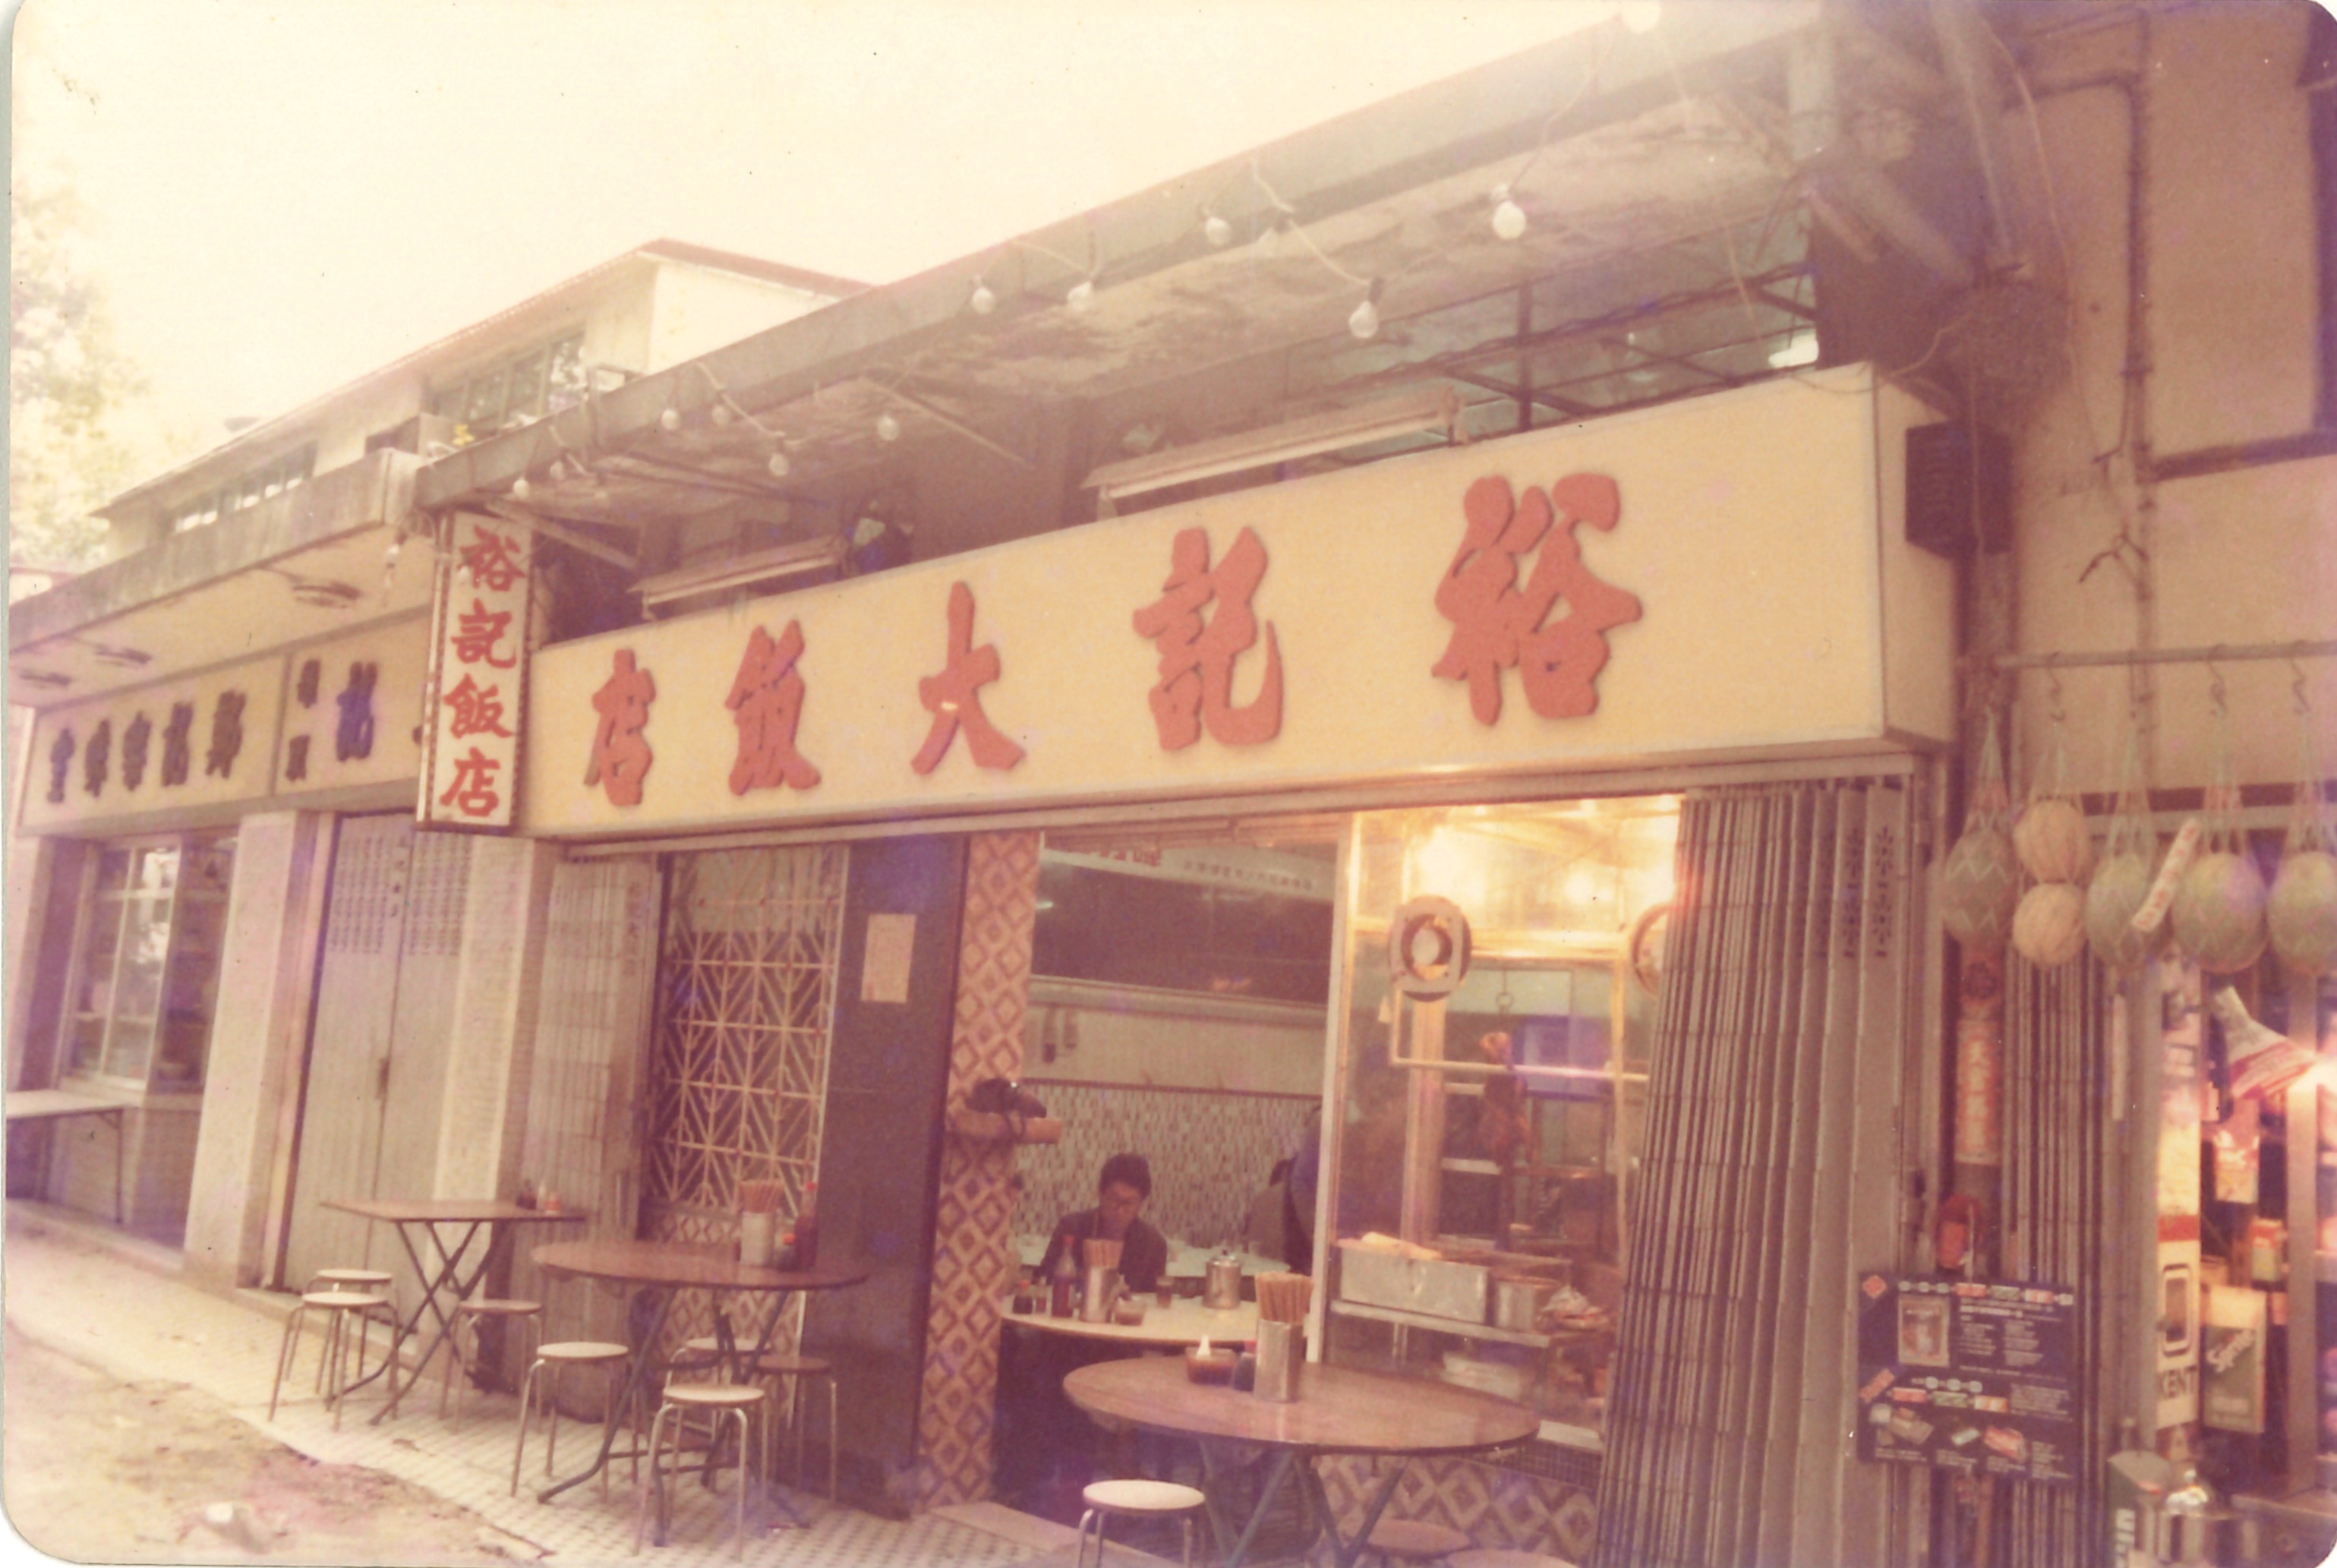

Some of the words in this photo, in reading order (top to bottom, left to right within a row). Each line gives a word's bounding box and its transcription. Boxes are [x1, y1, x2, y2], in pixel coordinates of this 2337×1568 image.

[438, 525, 527, 818] 裕記飯店
[583, 472, 1643, 806] 裕記大飯店
